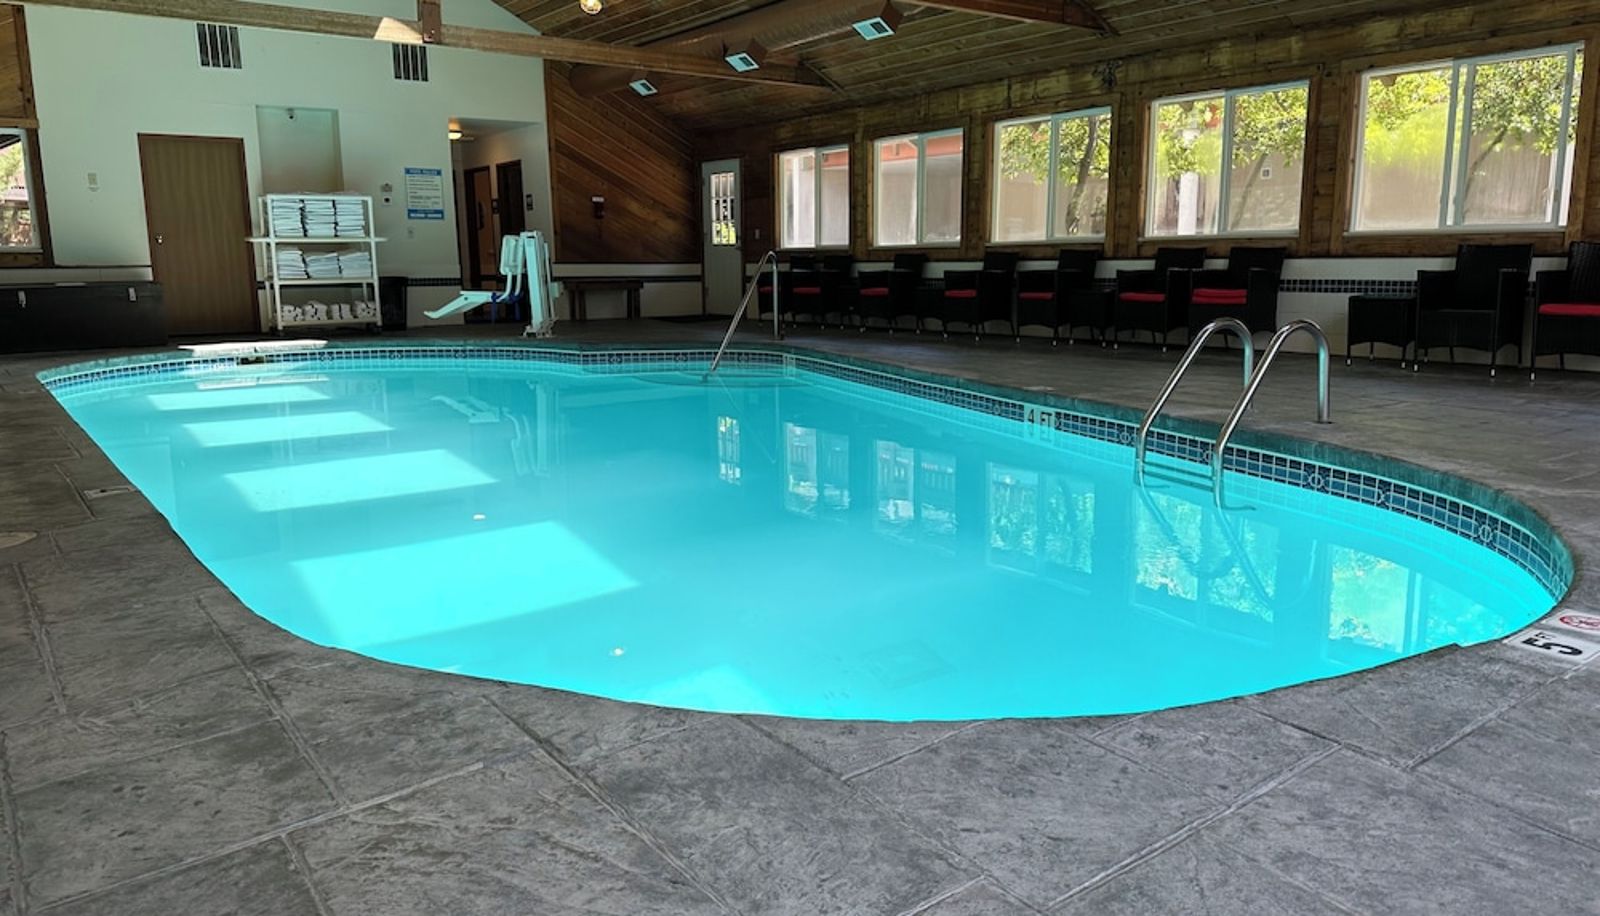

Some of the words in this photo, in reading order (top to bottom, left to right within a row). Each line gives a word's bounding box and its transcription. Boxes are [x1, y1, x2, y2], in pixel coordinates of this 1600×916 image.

[1027, 408, 1035, 424] 4
[1039, 411, 1053, 428] FT
[1521, 637, 1583, 656] 5
